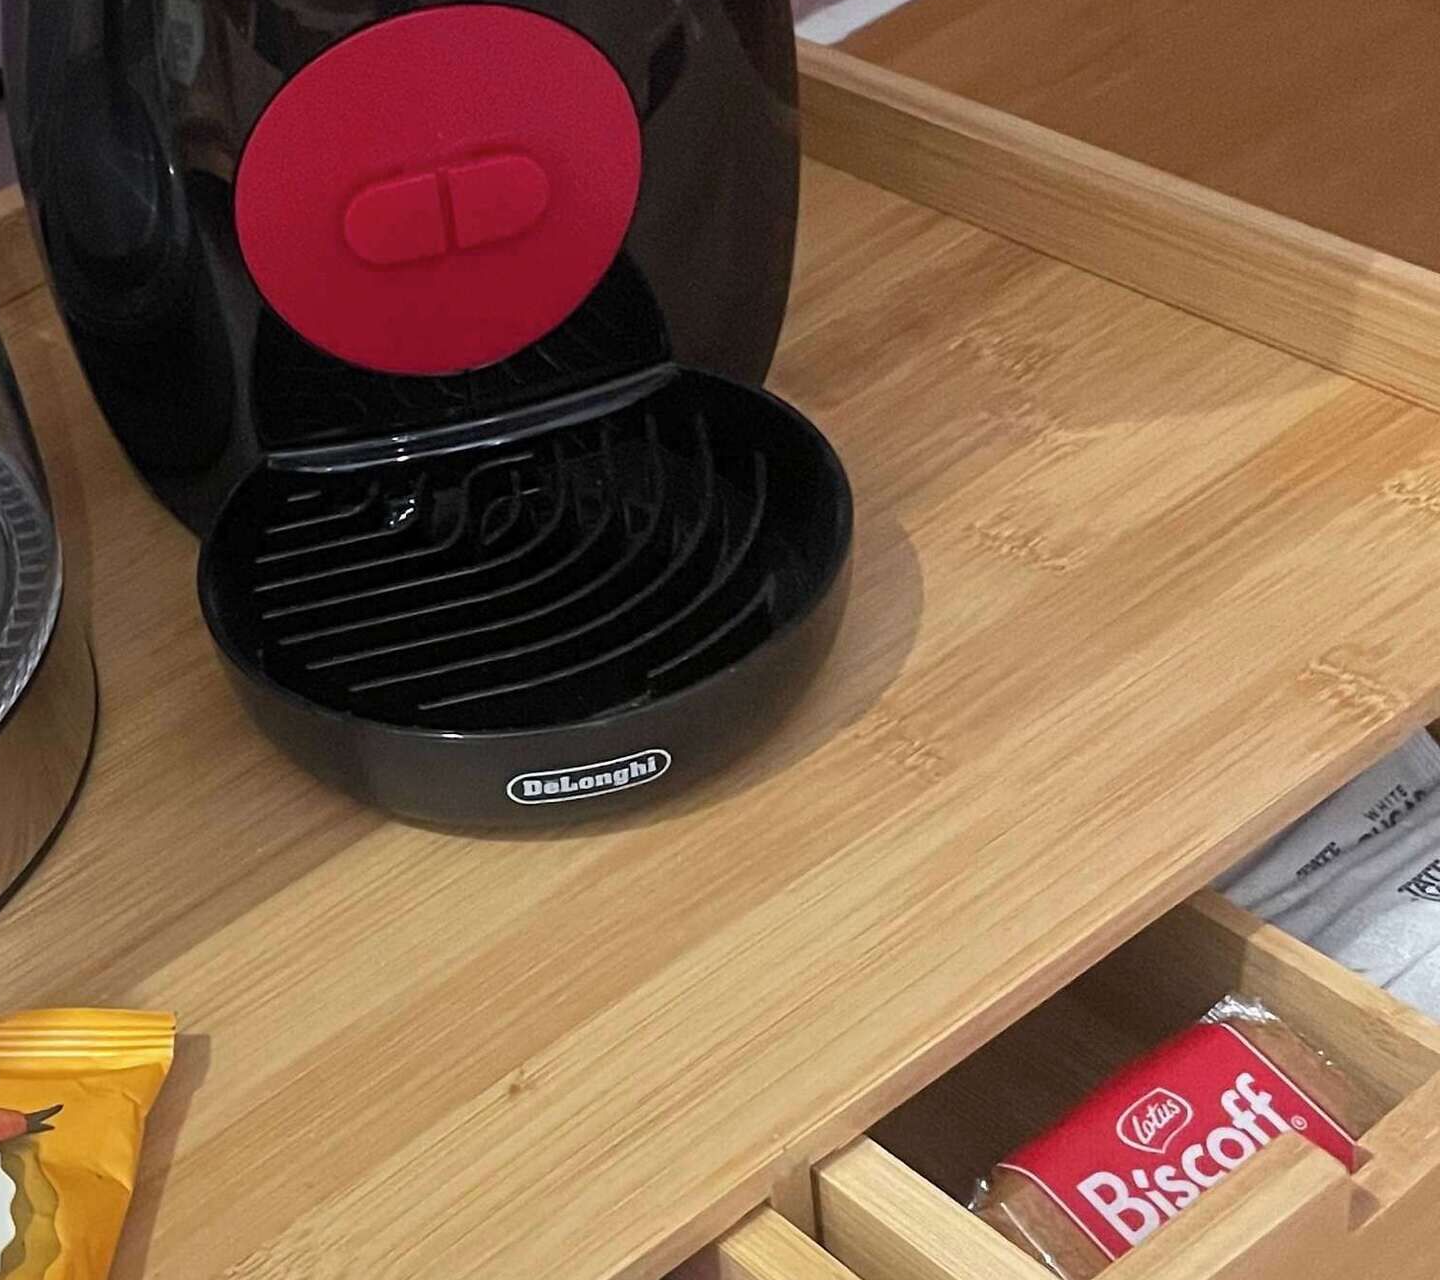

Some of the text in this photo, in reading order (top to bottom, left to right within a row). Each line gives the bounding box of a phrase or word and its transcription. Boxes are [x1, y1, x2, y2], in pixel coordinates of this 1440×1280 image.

[1363, 784, 1408, 822] WHITE
[1131, 1098, 1181, 1145] Lotus
[1076, 1072, 1295, 1247] Biscoff
